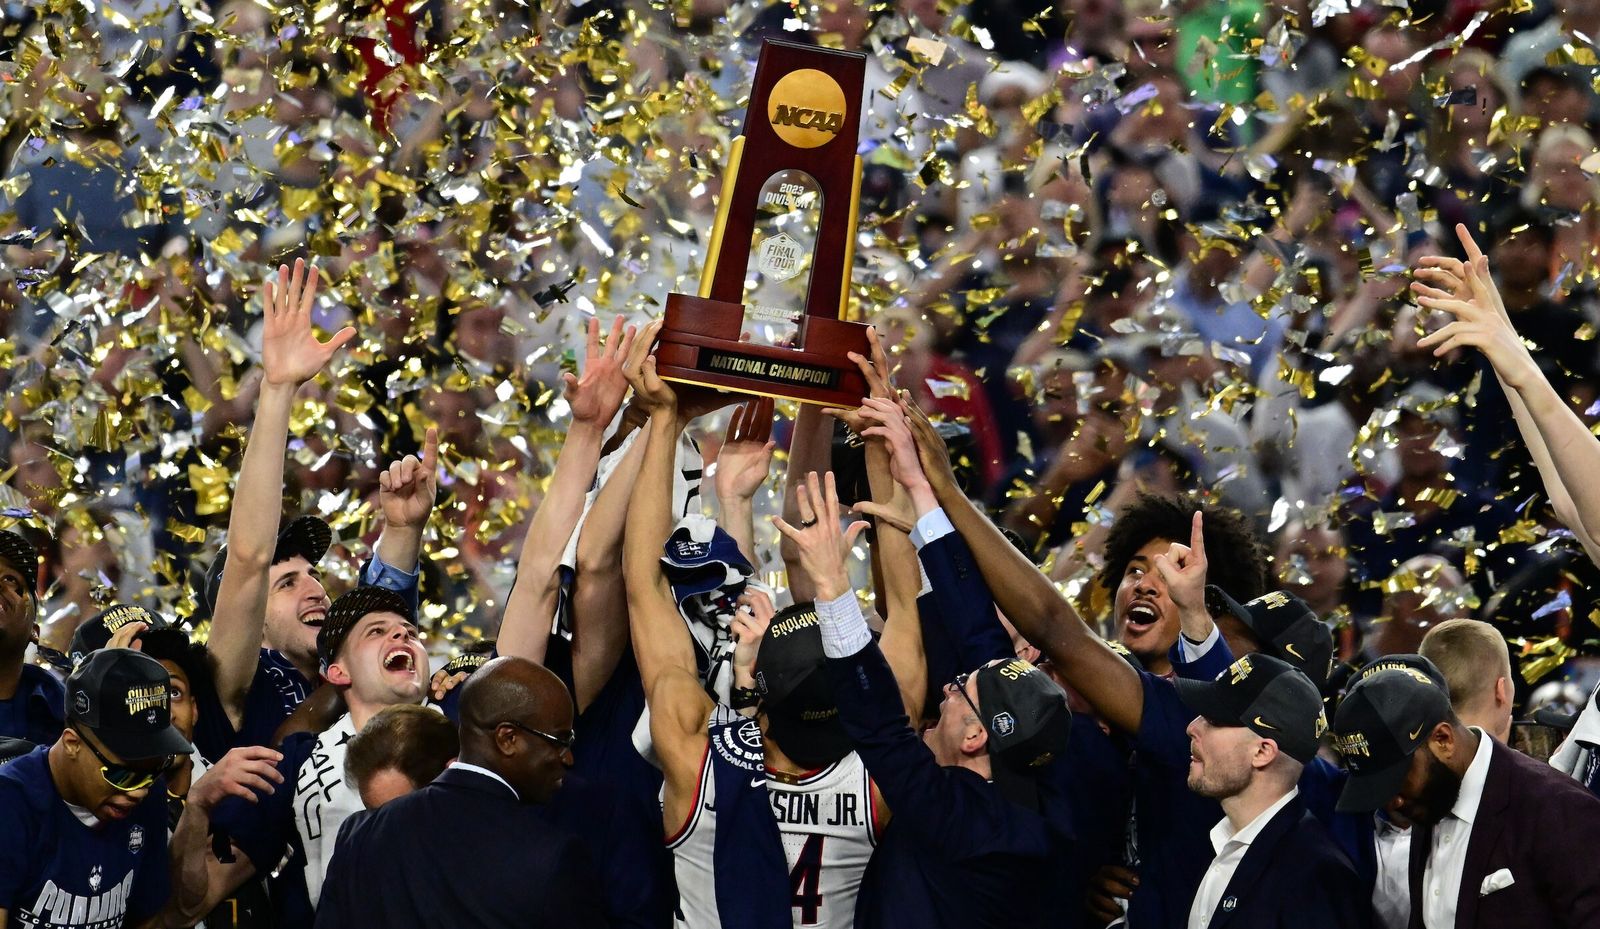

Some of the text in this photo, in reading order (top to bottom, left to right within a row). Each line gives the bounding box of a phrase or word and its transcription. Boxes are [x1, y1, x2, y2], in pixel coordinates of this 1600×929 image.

[772, 103, 844, 135] NCAA
[764, 191, 809, 210] DIVISION
[779, 183, 805, 196] 2023
[766, 244, 796, 259] FINAL
[767, 255, 796, 270] FOUR
[710, 354, 832, 386] NATIONAL CHAMPION
[712, 734, 754, 770] NATIONAL
[723, 727, 744, 756] MEN'S
[771, 792, 865, 826] SON JR.
[791, 832, 824, 925] 4
